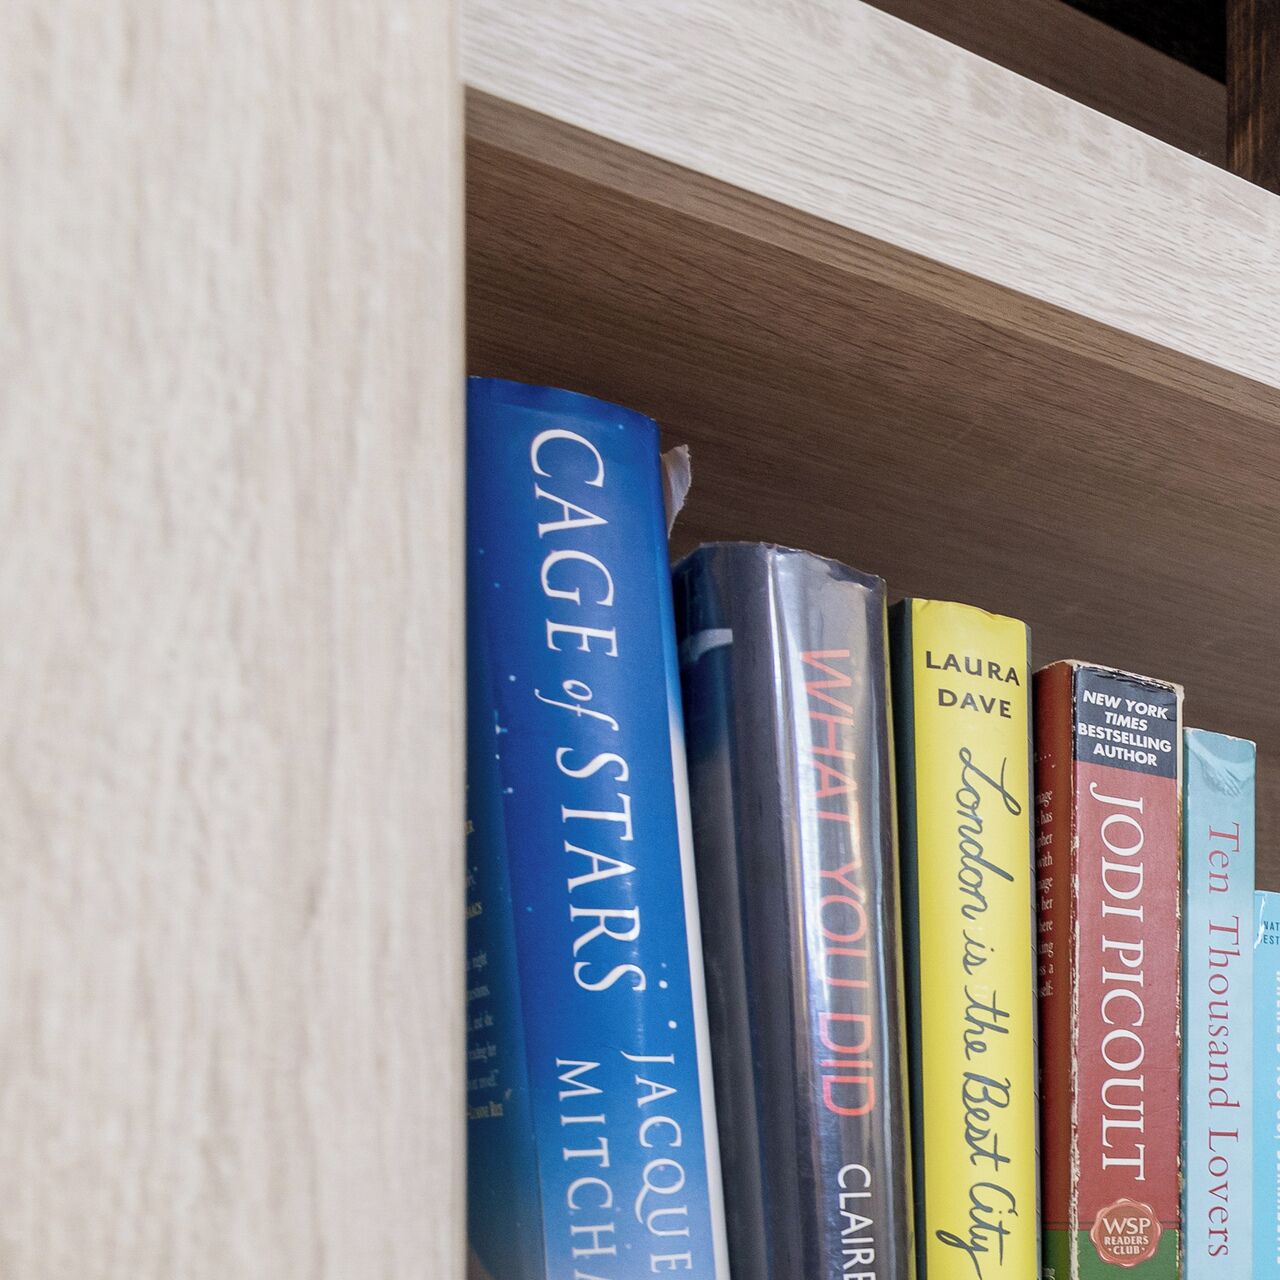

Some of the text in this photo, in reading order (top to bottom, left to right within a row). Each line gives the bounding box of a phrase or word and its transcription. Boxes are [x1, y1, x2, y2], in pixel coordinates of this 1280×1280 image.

[926, 651, 1021, 687] LAURA
[530, 428, 647, 993] CAGE of STARS
[938, 687, 1012, 719] DAVE
[1083, 689, 1169, 720] NEW YORK
[1104, 711, 1148, 732] TIMES
[799, 649, 861, 867] WHAT
[1078, 722, 1172, 753] BESTSELLING
[1093, 742, 1158, 767] AUTHOR
[956, 747, 1022, 921] London
[963, 928, 995, 977] is
[1091, 782, 1146, 1182] JODI PICOULT
[964, 984, 1011, 1061] the
[1207, 822, 1241, 1257] Ten Thousand Lovers
[818, 1012, 875, 1117] DID
[962, 1071, 1011, 1172] Best
[936, 1181, 1019, 1280] City
[1102, 1217, 1151, 1235] WSP
[1104, 1235, 1149, 1246] READERS
[1113, 1245, 1140, 1255] CLUB
